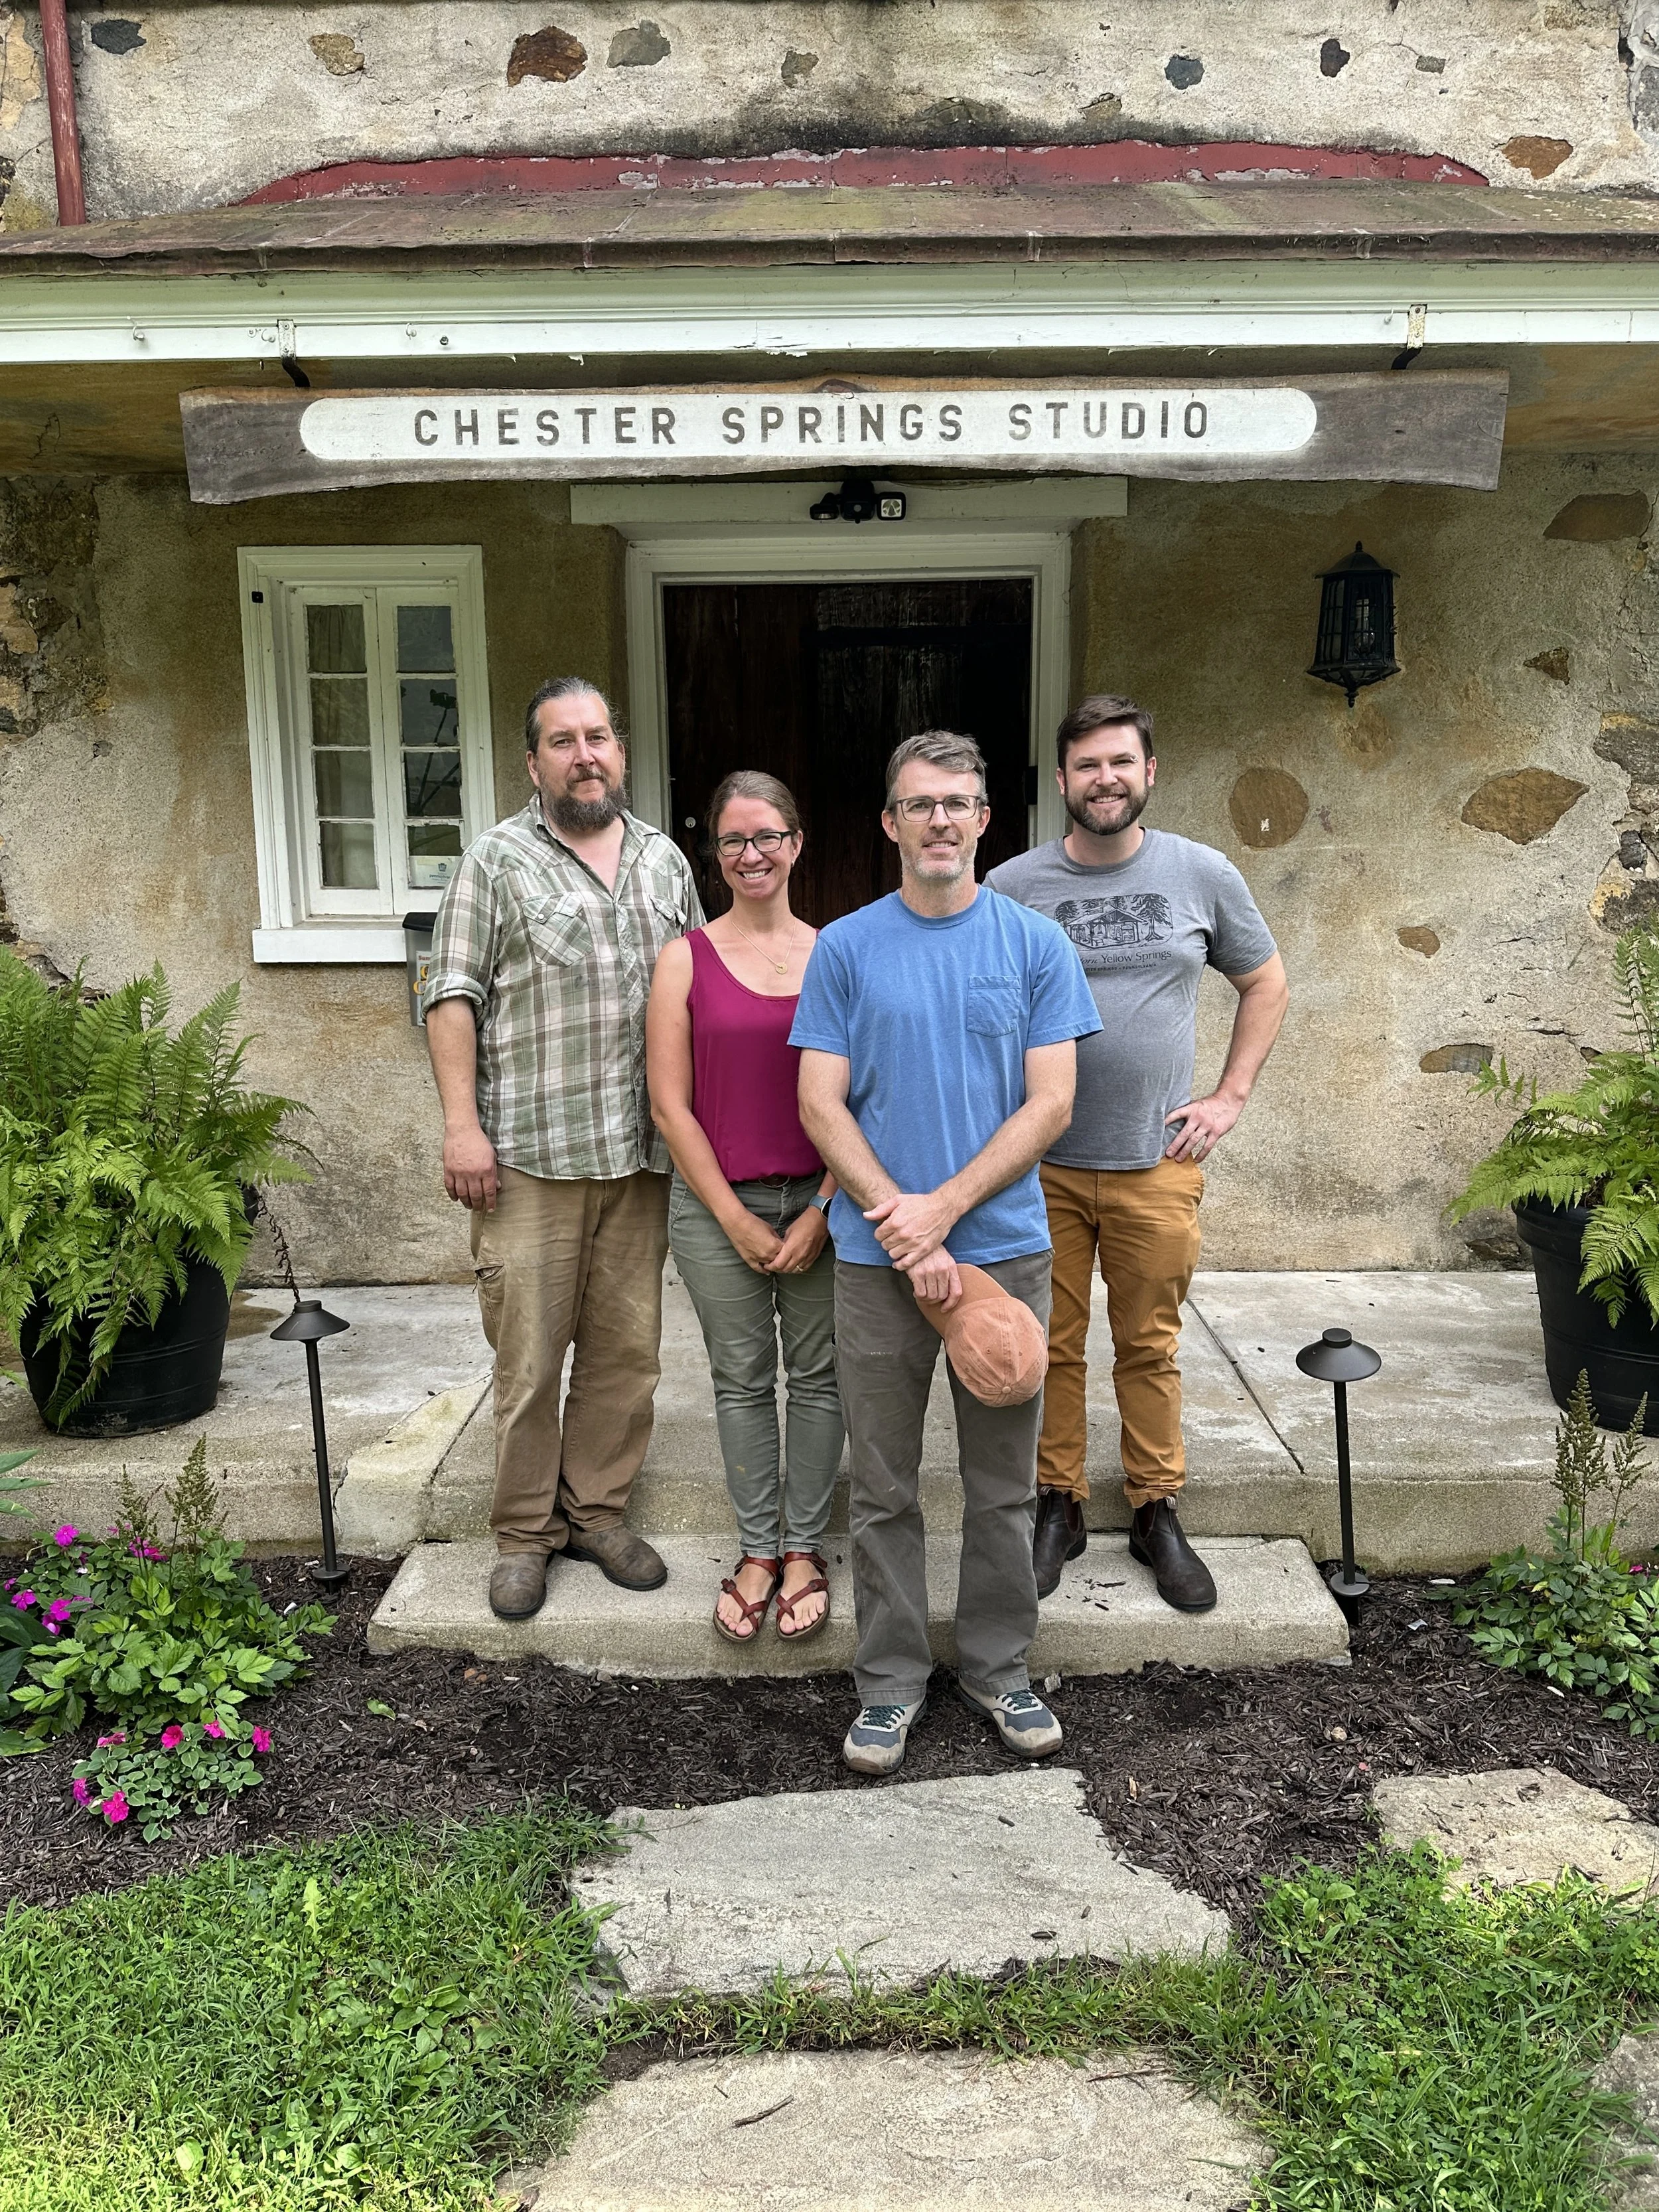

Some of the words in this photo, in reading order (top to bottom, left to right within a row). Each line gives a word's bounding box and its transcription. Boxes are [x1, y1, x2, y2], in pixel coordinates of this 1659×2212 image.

[414, 407, 676, 446] CHESTER
[722, 404, 963, 445] SPRINGS
[1009, 401, 1208, 441] STUDIO
[1101, 954, 1133, 964] Yellow
[1135, 950, 1172, 962] Springs
